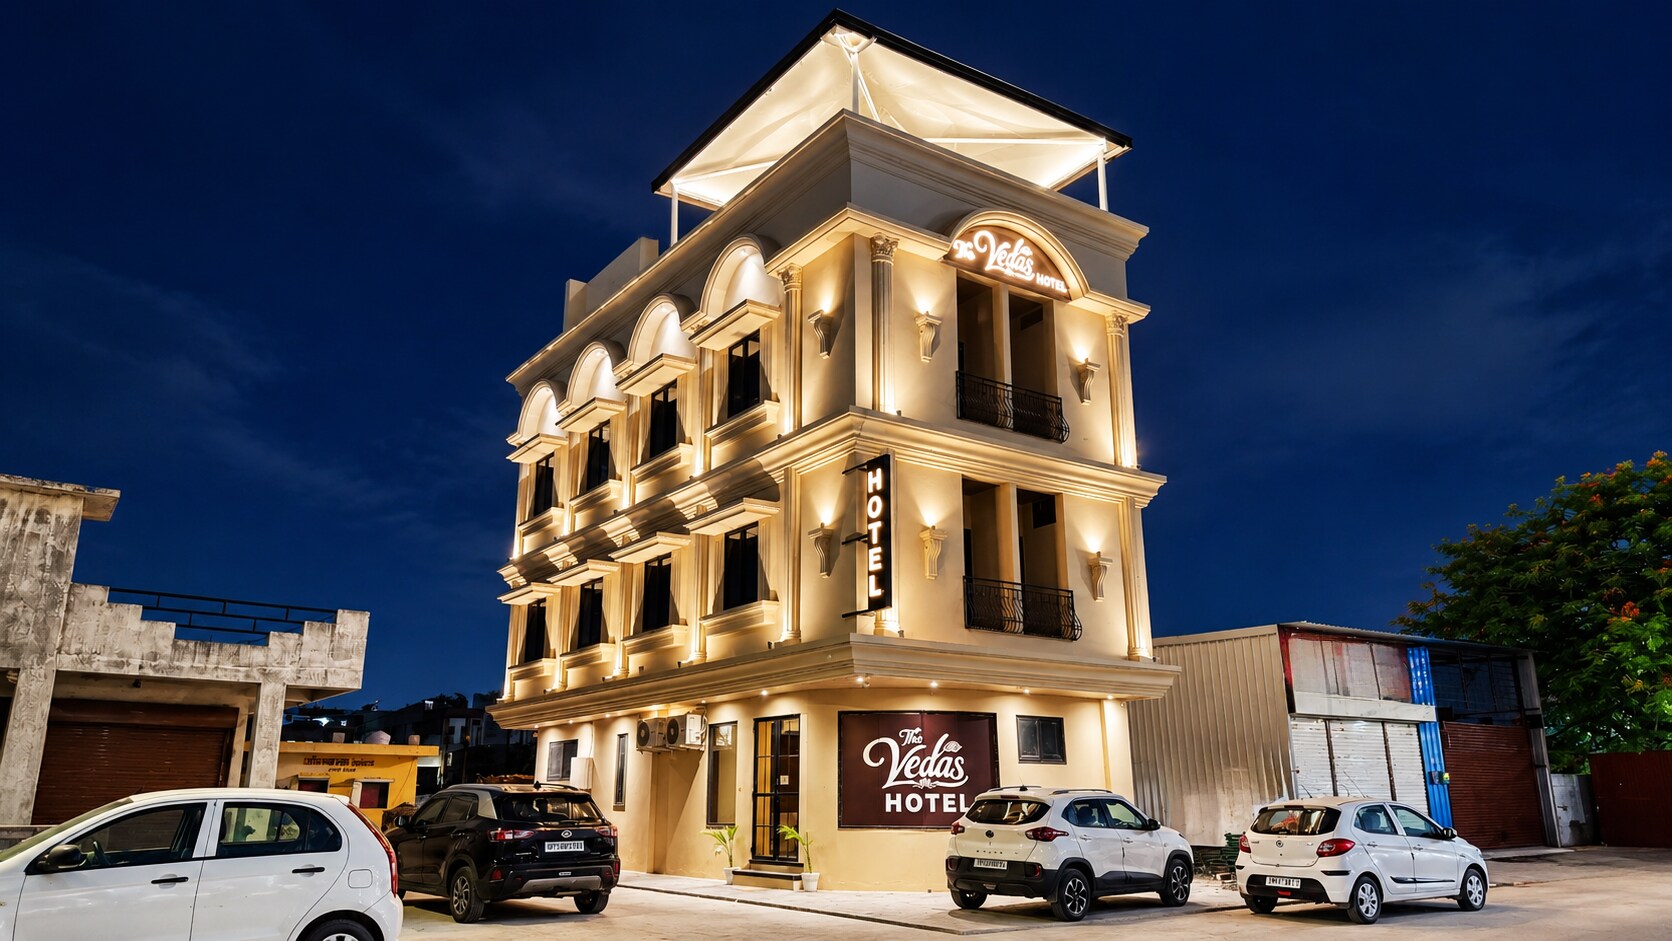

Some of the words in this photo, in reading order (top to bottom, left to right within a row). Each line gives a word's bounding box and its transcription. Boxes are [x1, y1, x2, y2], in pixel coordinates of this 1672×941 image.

[973, 230, 1035, 281] Vedas
[1036, 273, 1068, 293] HOTEL
[867, 467, 883, 598] HOTEL
[862, 733, 969, 789] Vedas
[899, 727, 923, 746] The
[885, 793, 970, 813] HOTEL
